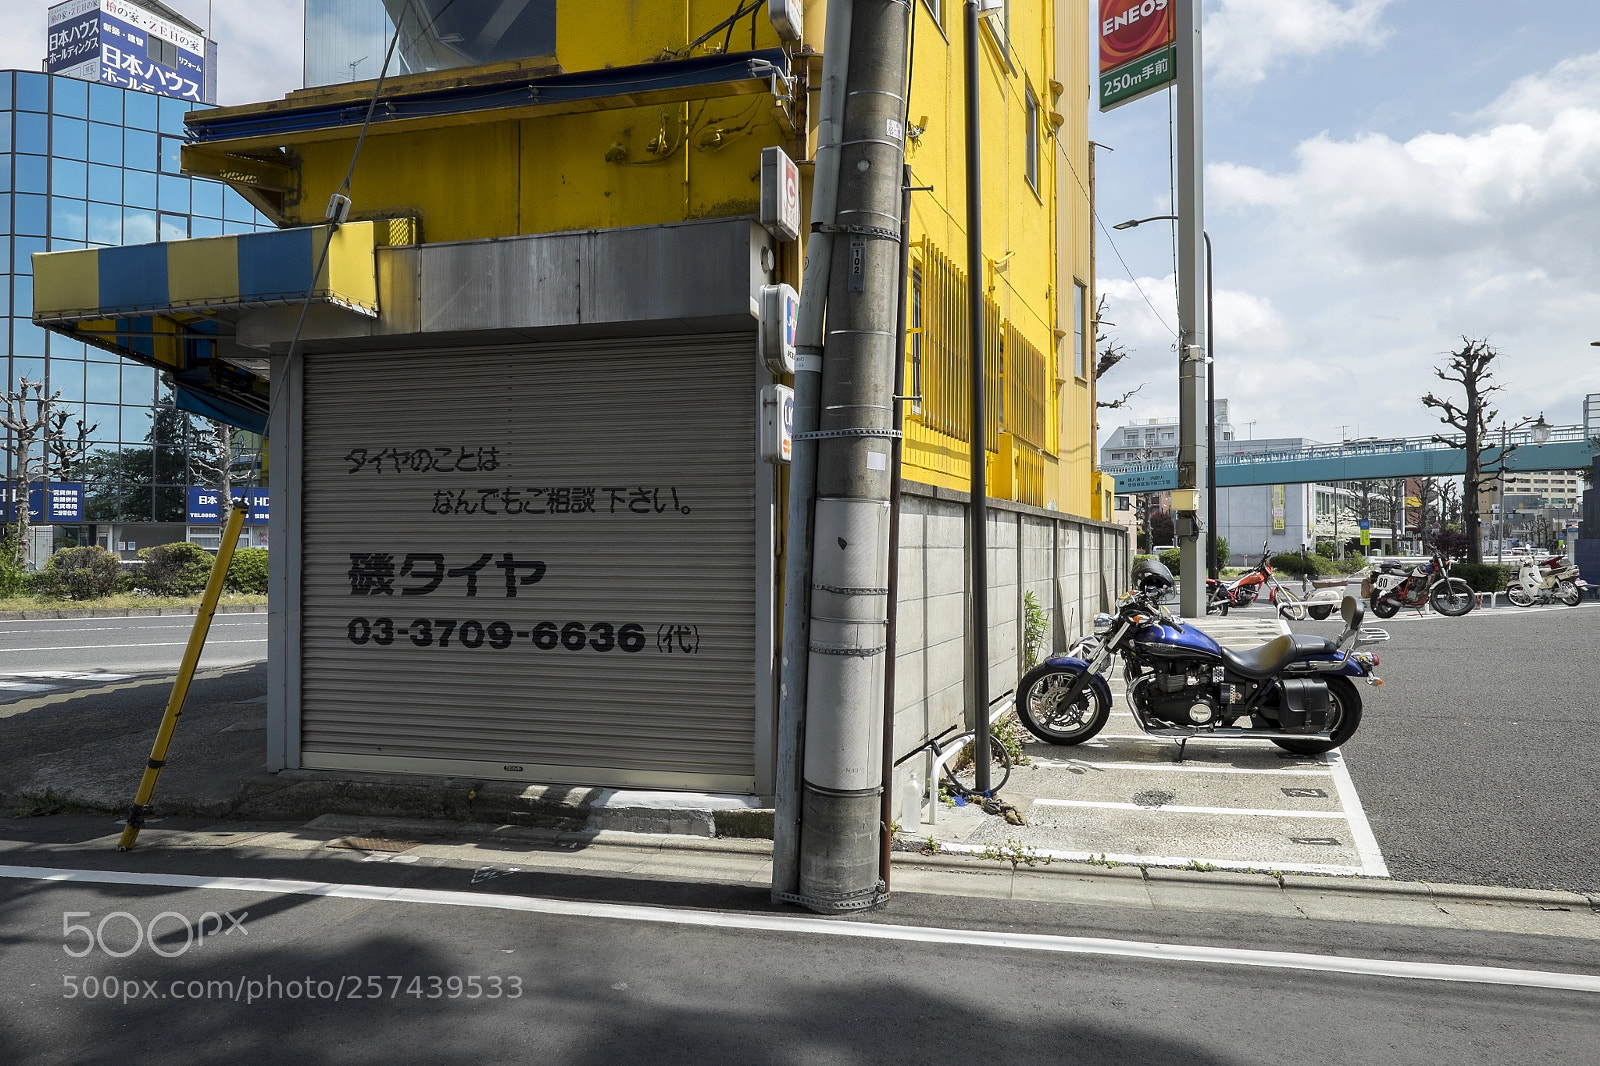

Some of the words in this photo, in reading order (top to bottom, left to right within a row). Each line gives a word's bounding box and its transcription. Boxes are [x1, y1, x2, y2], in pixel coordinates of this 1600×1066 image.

[49, 18, 100, 51] 日本ハウス
[1102, 0, 1168, 37] ENEOS
[49, 37, 99, 64] ホールディングス
[179, 56, 202, 72] リフォーム
[102, 43, 200, 102] 日本ハウス
[1104, 58, 1169, 97] 250m手前
[853, 249, 861, 274] 102
[344, 446, 500, 474] タイヤのことは
[431, 486, 692, 515] なんでもご相談下さい。
[348, 552, 547, 598] 磯タイヤ
[347, 616, 647, 653] 03-3709-6636
[656, 623, 700, 654] (代)
